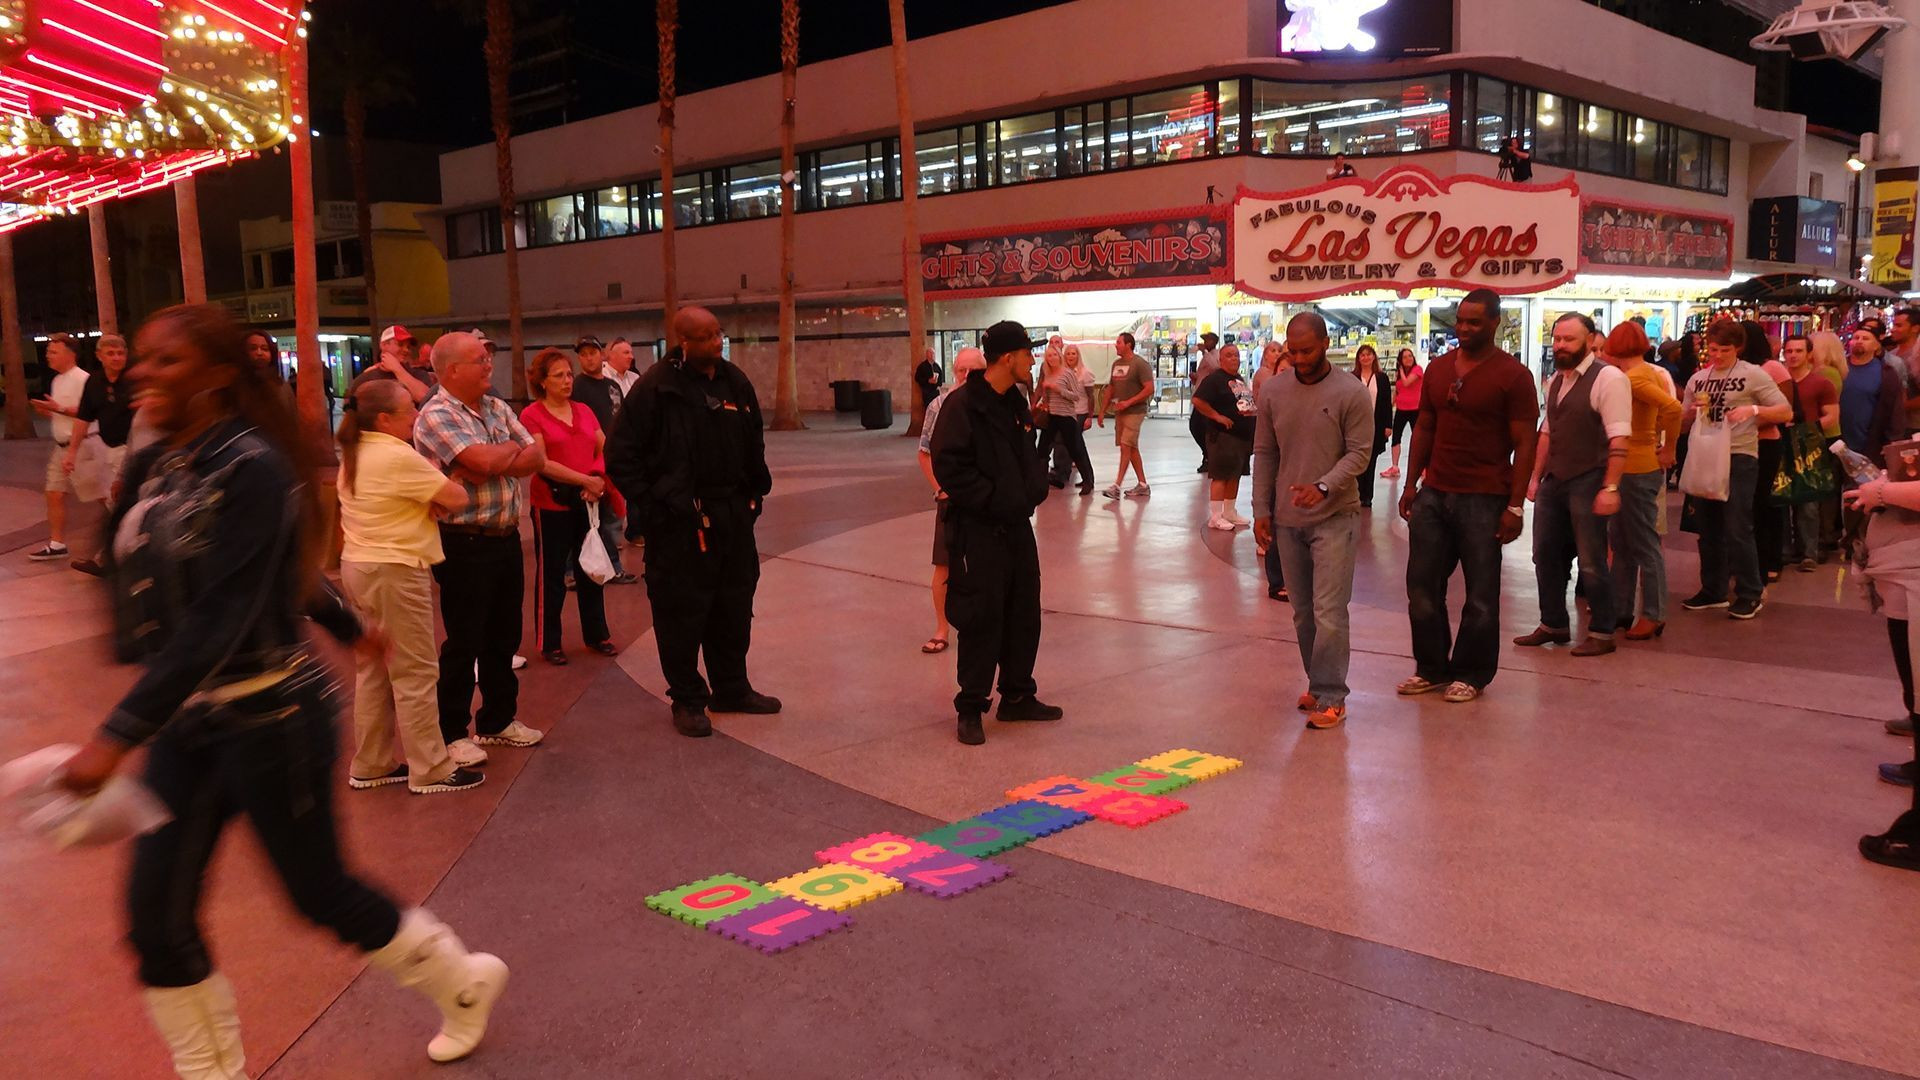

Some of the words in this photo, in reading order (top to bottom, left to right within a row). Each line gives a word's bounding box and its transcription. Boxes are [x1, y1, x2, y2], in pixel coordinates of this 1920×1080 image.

[1249, 199, 1377, 230] FABULOUS
[1801, 223, 1832, 243] ALLURE
[1268, 213, 1371, 263] Las
[1385, 211, 1538, 278] Vegas
[921, 251, 996, 279] GIFTS
[1002, 249, 1023, 274] &
[1030, 233, 1212, 273] SOUVENIRS
[1270, 262, 1401, 281] JEWELRY
[1417, 261, 1437, 278] &
[1481, 257, 1565, 276] GIFTS
[1694, 377, 1746, 393] WITNESS
[1114, 771, 1169, 788] 2
[1037, 784, 1089, 798] 4
[1102, 798, 1158, 815] 3
[850, 840, 912, 863] 8
